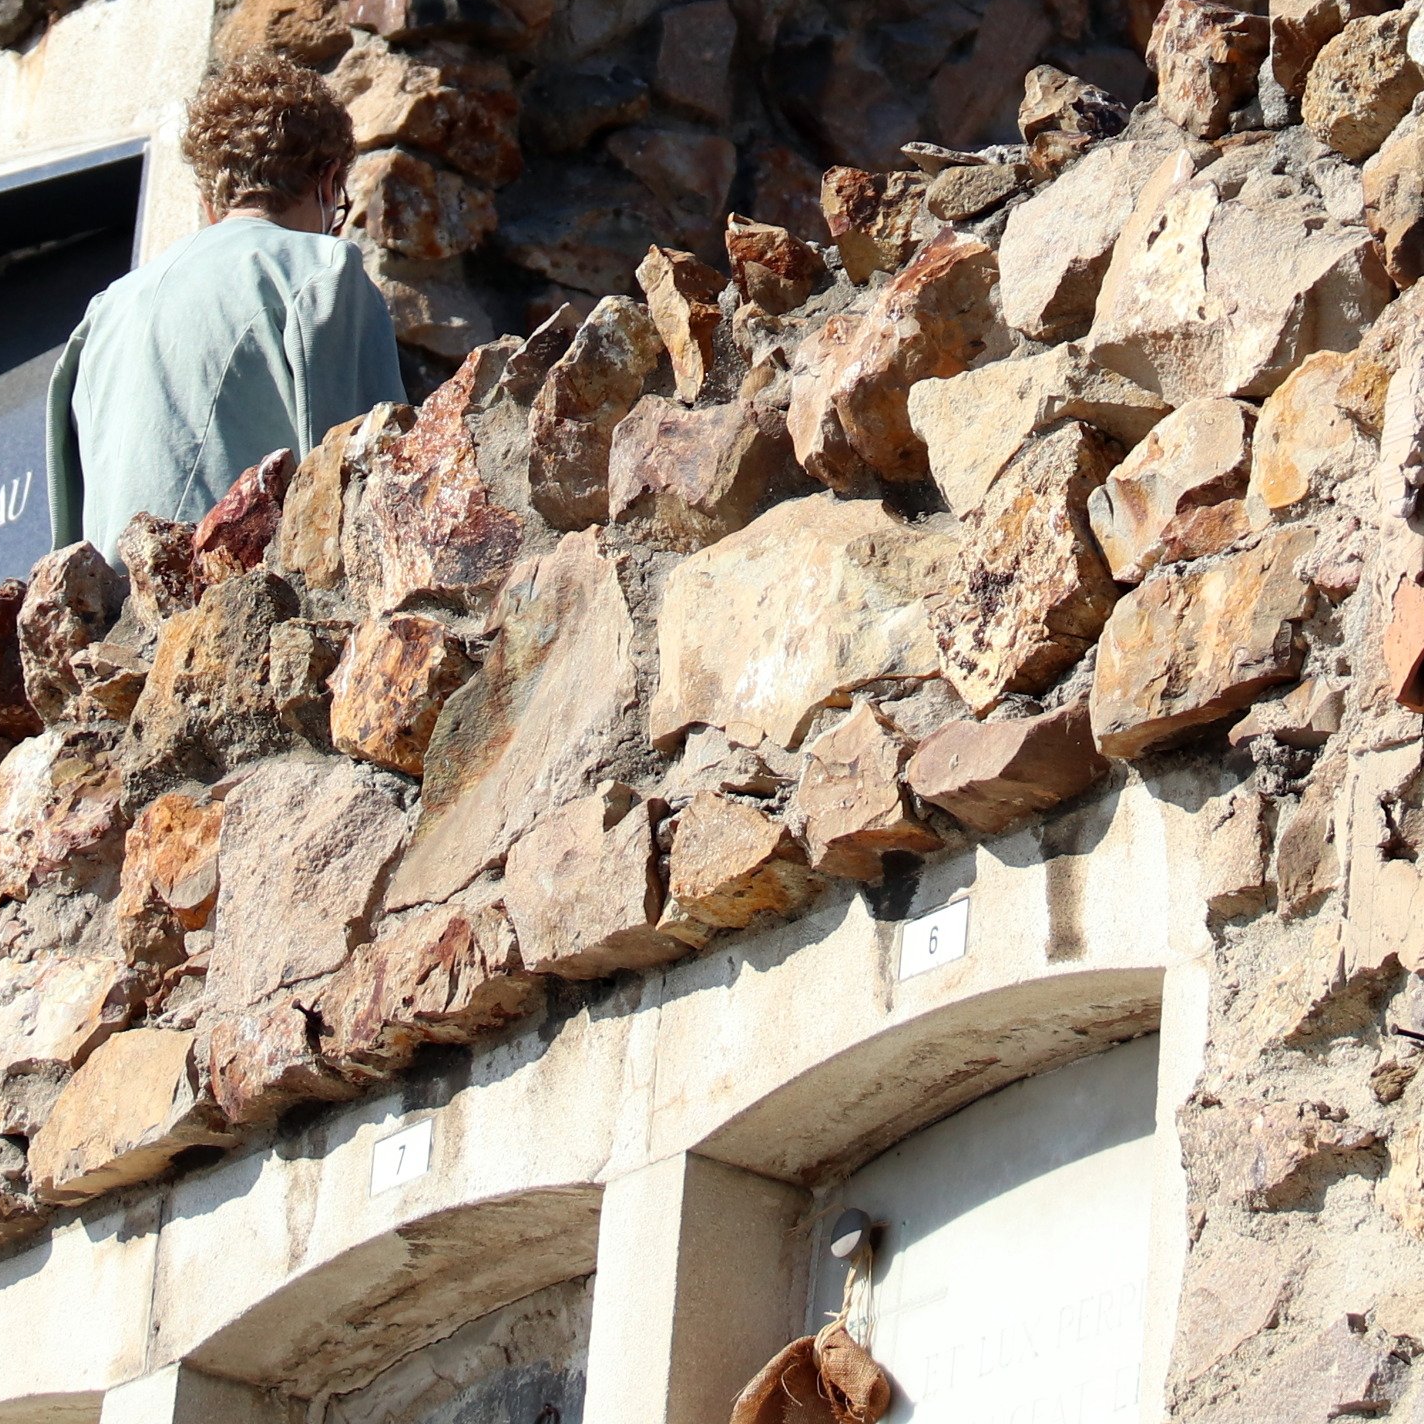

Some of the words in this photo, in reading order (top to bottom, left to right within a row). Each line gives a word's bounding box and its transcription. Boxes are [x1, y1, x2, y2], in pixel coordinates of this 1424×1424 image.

[928, 925, 940, 955] 6
[395, 1144, 407, 1176] 7
[977, 1313, 1044, 1379] LUX
